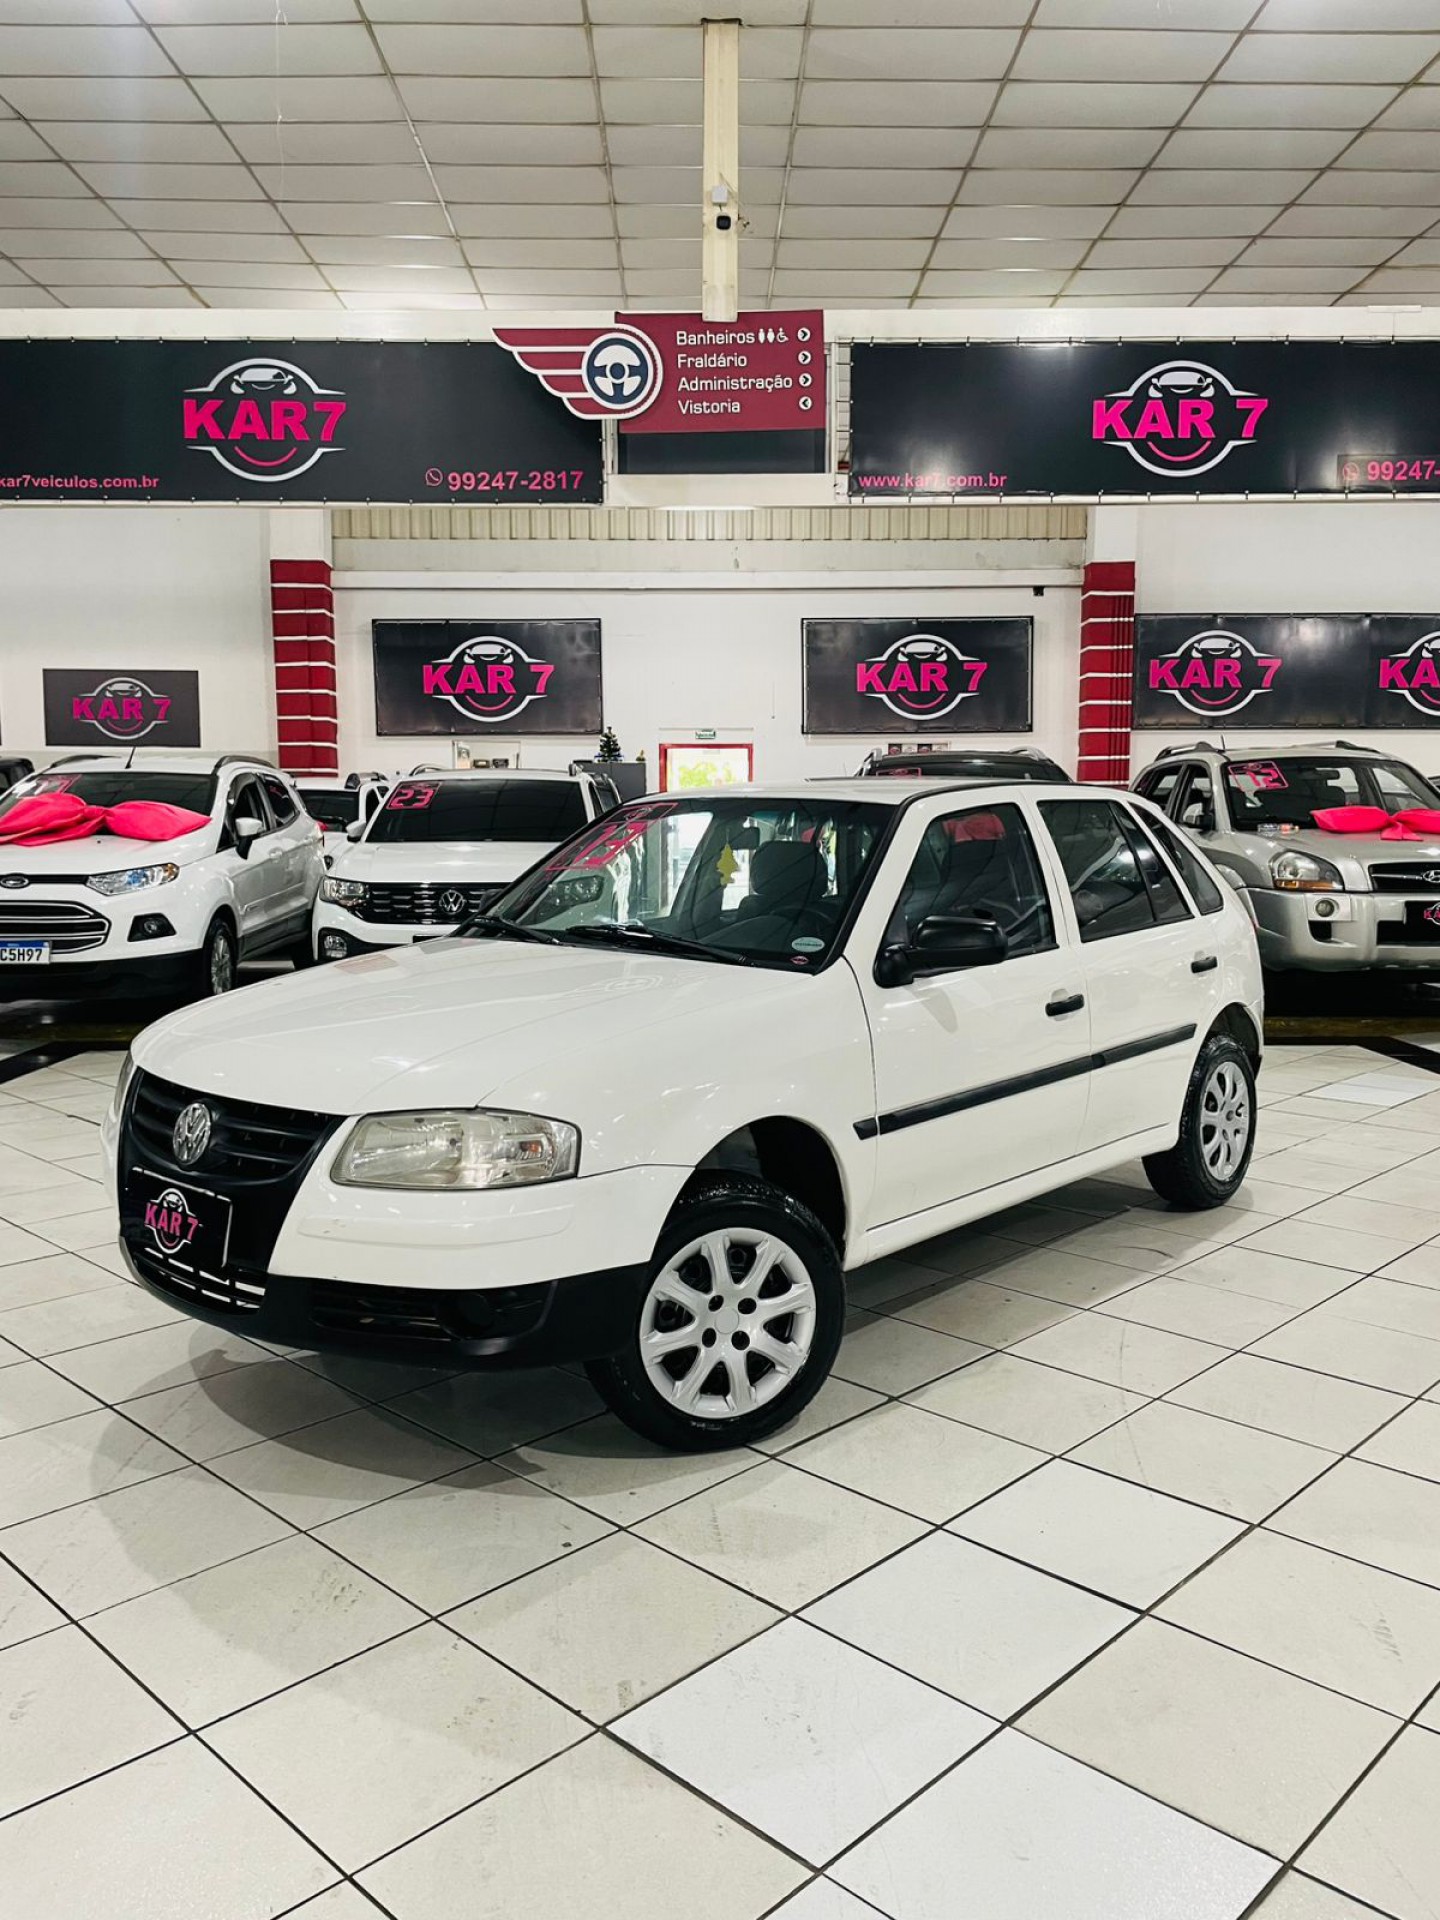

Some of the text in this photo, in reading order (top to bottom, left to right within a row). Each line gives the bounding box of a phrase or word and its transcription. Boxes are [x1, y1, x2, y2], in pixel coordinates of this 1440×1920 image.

[676, 329, 755, 346] Banheiros
[676, 352, 748, 370] Fraldário
[677, 374, 793, 394] Administração
[677, 399, 741, 415] Vistoria
[1092, 398, 1269, 441] KAR 7
[447, 470, 585, 491] 99247-2817
[858, 472, 1008, 488] www.kar7.com.br
[423, 663, 556, 695] KAR 7
[856, 661, 989, 693] KAR 7
[1149, 658, 1283, 689] KAR 7
[72, 696, 172, 721] KAR 7
[390, 788, 434, 808] 23
[144, 1202, 199, 1241] KAR 7
